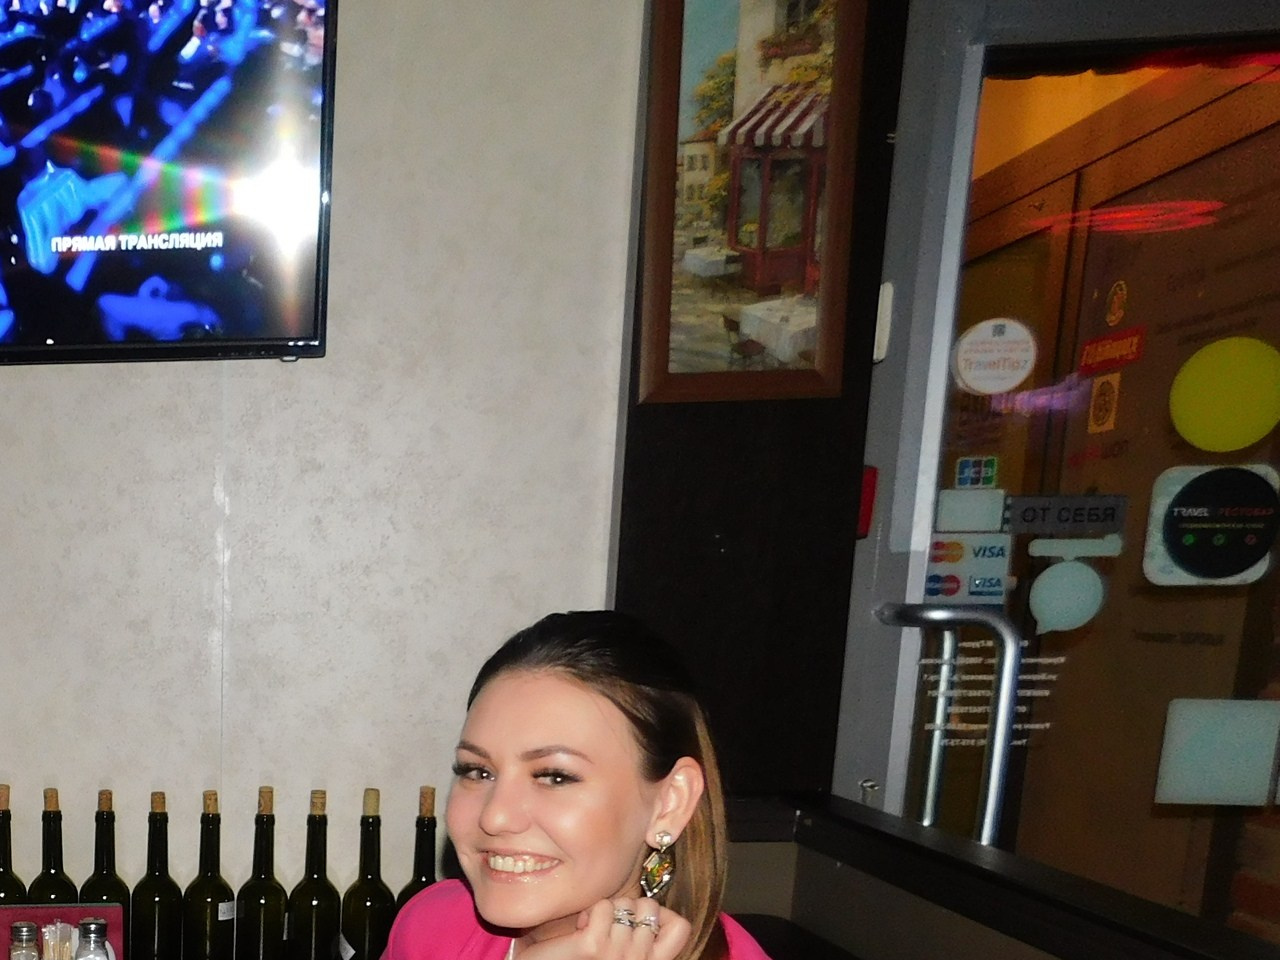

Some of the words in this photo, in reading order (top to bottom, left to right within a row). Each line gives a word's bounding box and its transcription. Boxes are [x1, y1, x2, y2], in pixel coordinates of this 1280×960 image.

[51, 235, 117, 252] ПРЯМАЯ
[119, 231, 224, 251] ТРАНСЛЯЦИЯ
[1021, 506, 1051, 523] ОТ
[1056, 506, 1116, 523] СЕБЯ
[972, 545, 1006, 559] VISA
[973, 577, 1003, 589] VISA
